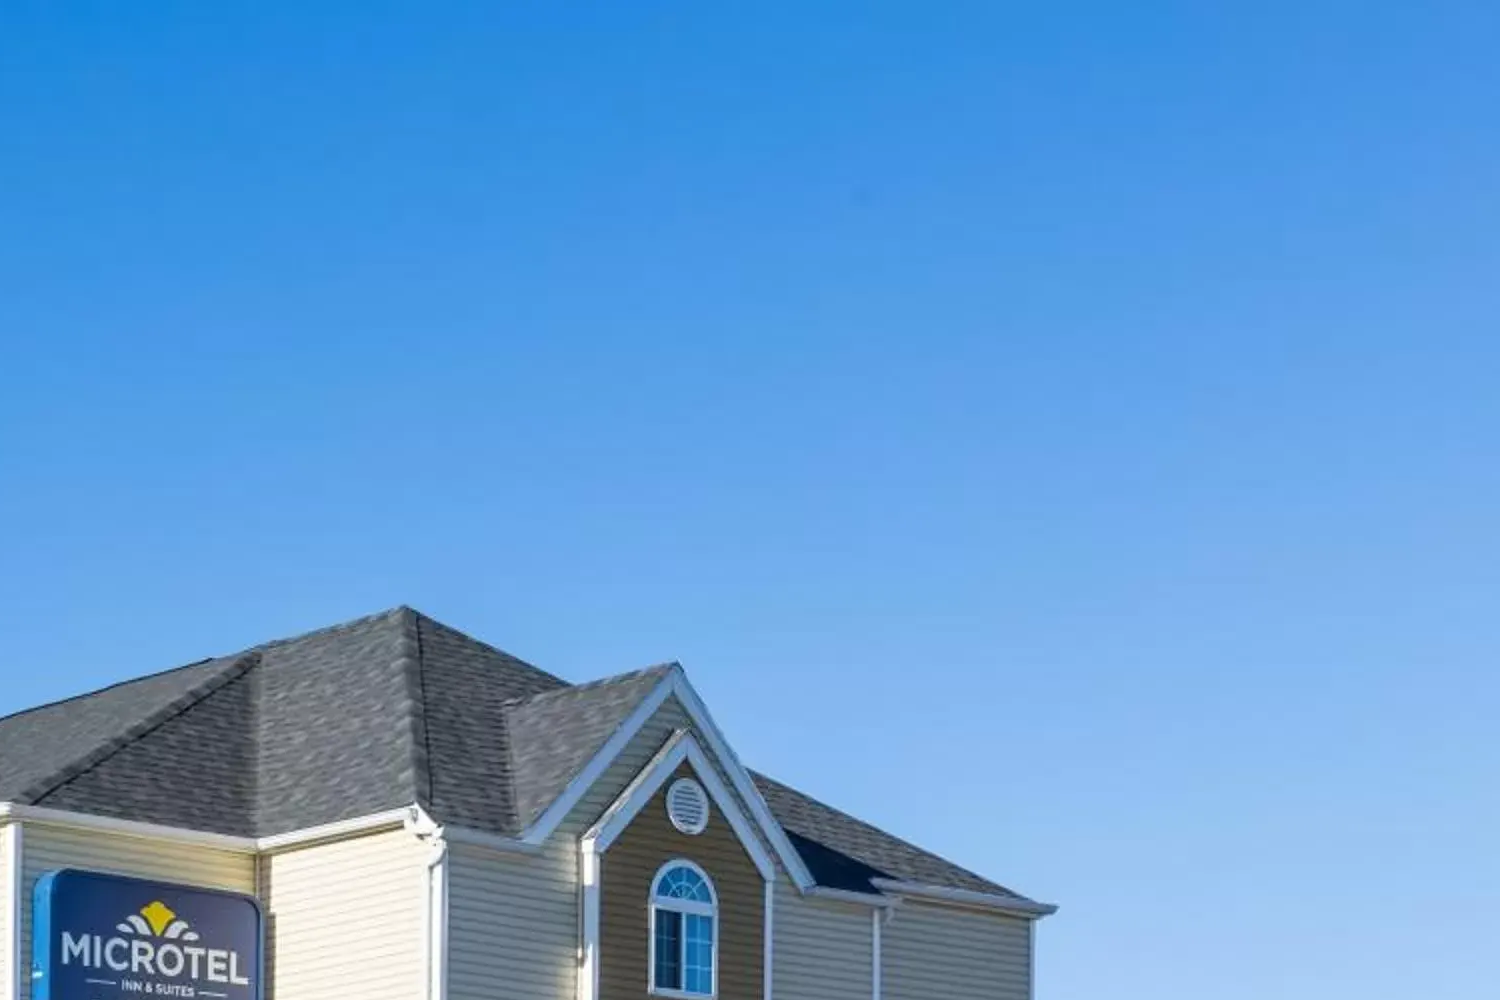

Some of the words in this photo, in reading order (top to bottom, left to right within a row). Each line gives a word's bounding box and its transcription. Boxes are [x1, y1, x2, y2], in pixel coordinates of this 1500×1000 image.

[61, 931, 249, 985] MICROTEL
[121, 979, 142, 991] INN
[145, 982, 153, 993] &
[155, 983, 195, 997] SUITES
